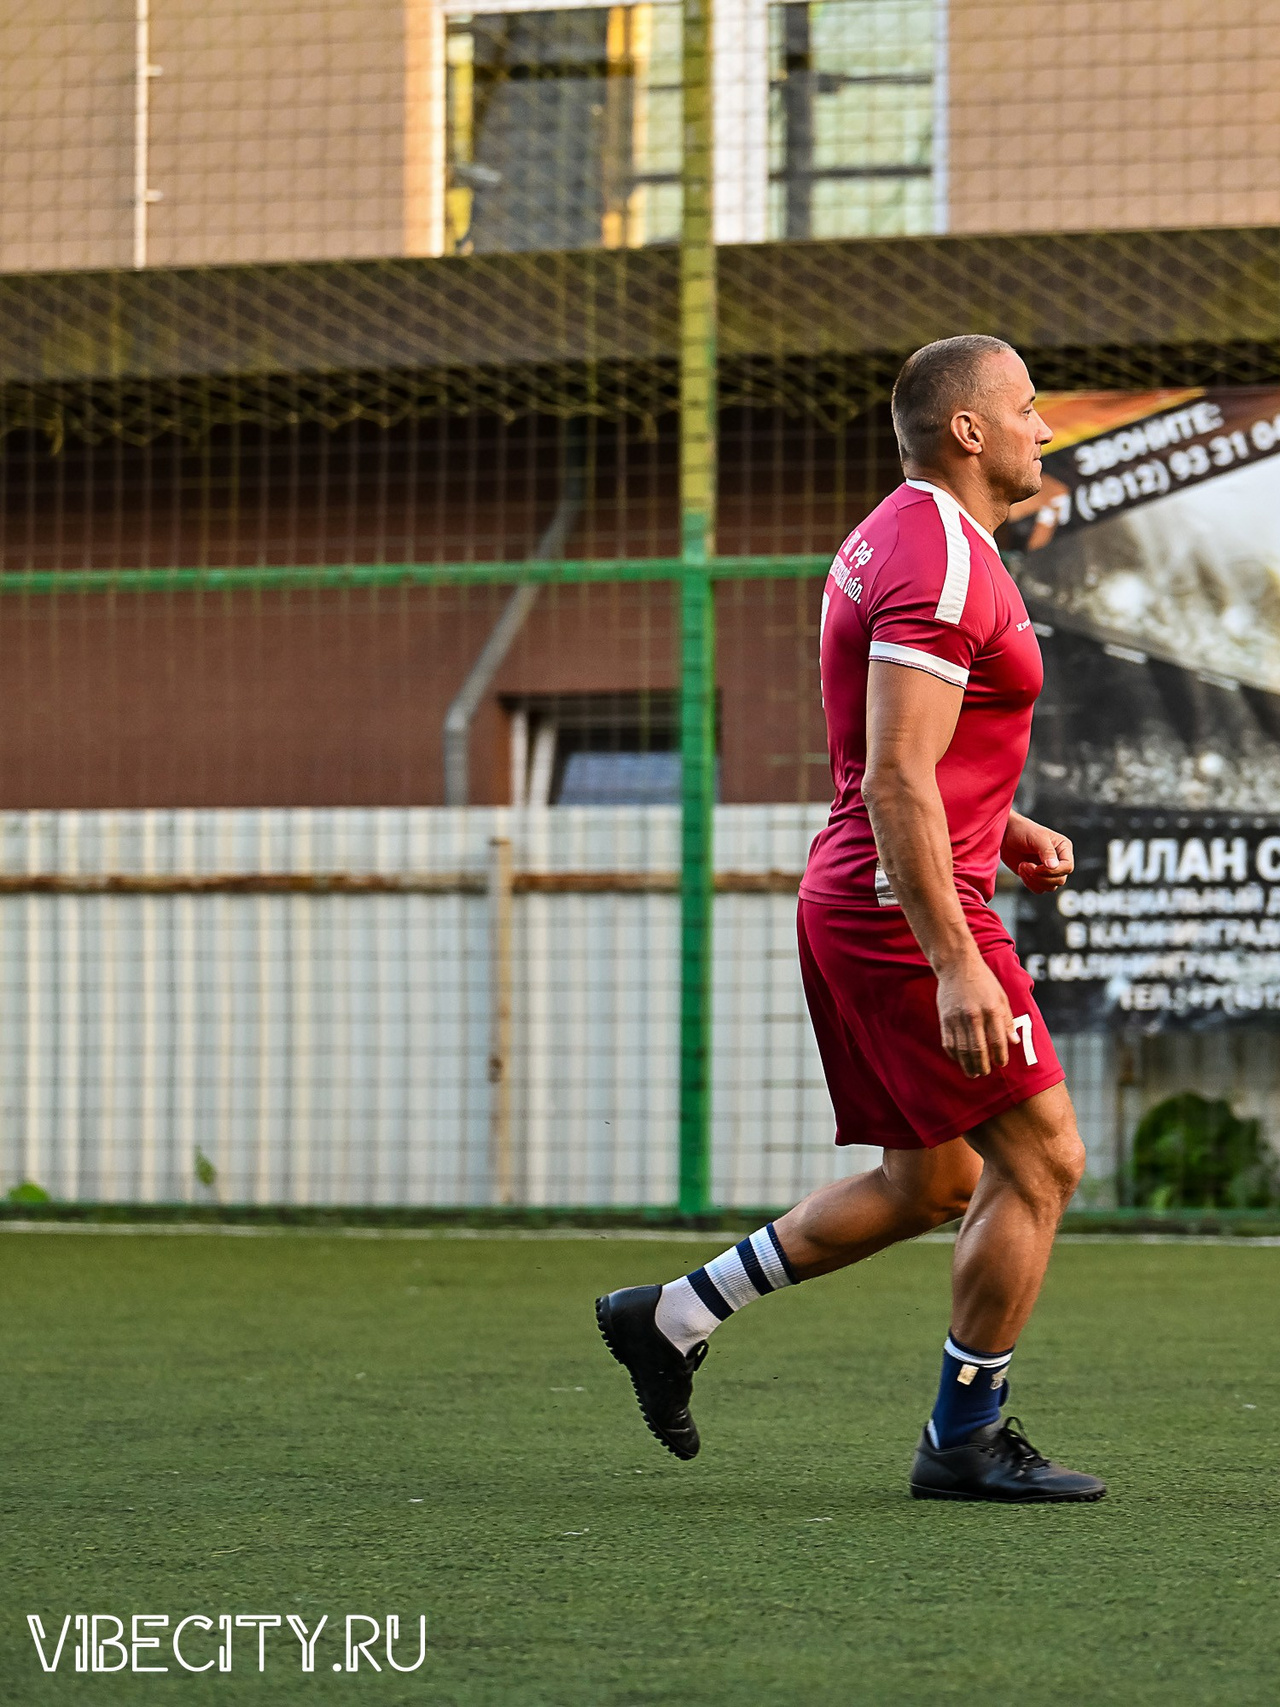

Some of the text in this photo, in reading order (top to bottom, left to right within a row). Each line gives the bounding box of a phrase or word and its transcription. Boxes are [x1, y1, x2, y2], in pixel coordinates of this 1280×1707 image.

[1074, 402, 1226, 477] ЗВОНИТЕ:
[1075, 458, 1172, 522] (4012)
[1168, 444, 1212, 481] 93
[1209, 429, 1251, 467] 31
[1108, 837, 1247, 885] ИЛАН
[1066, 920, 1088, 948] В
